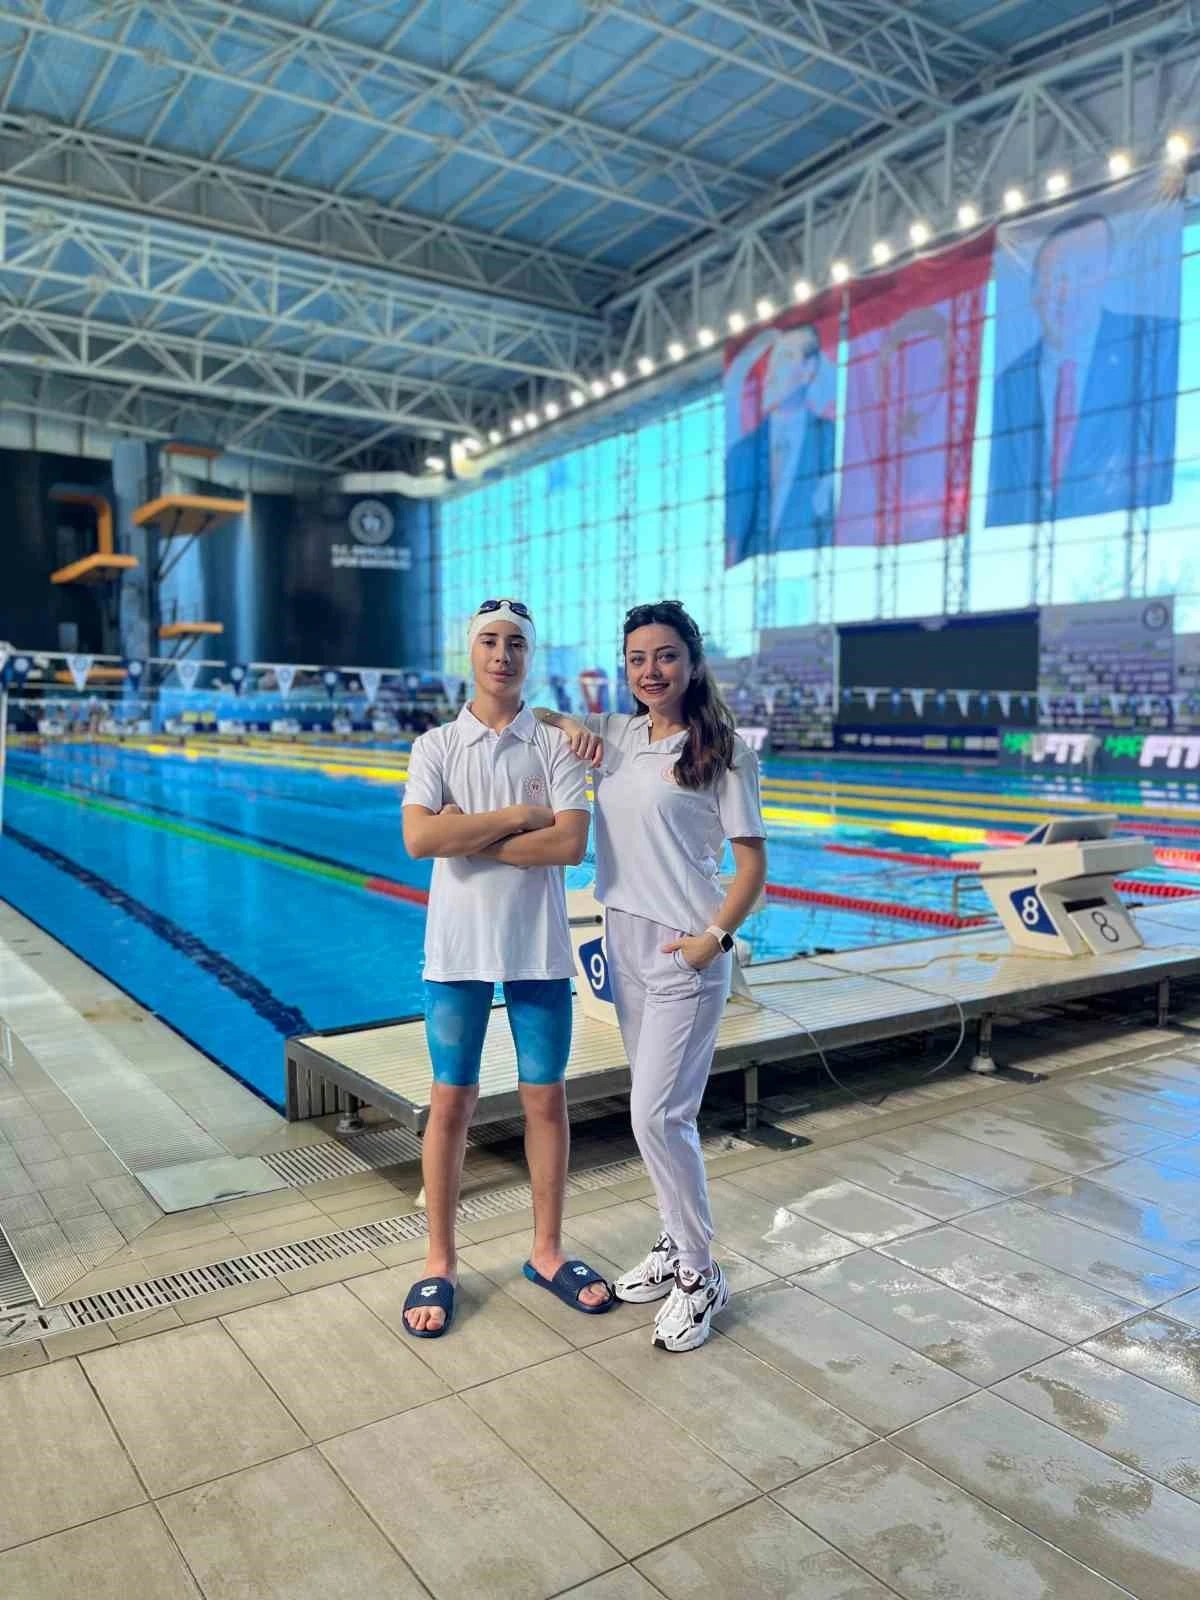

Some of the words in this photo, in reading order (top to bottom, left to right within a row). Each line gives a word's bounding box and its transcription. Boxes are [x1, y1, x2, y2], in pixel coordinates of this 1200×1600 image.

[1022, 895, 1039, 925] 8
[1085, 911, 1119, 943] 8
[590, 953, 605, 990] 9
